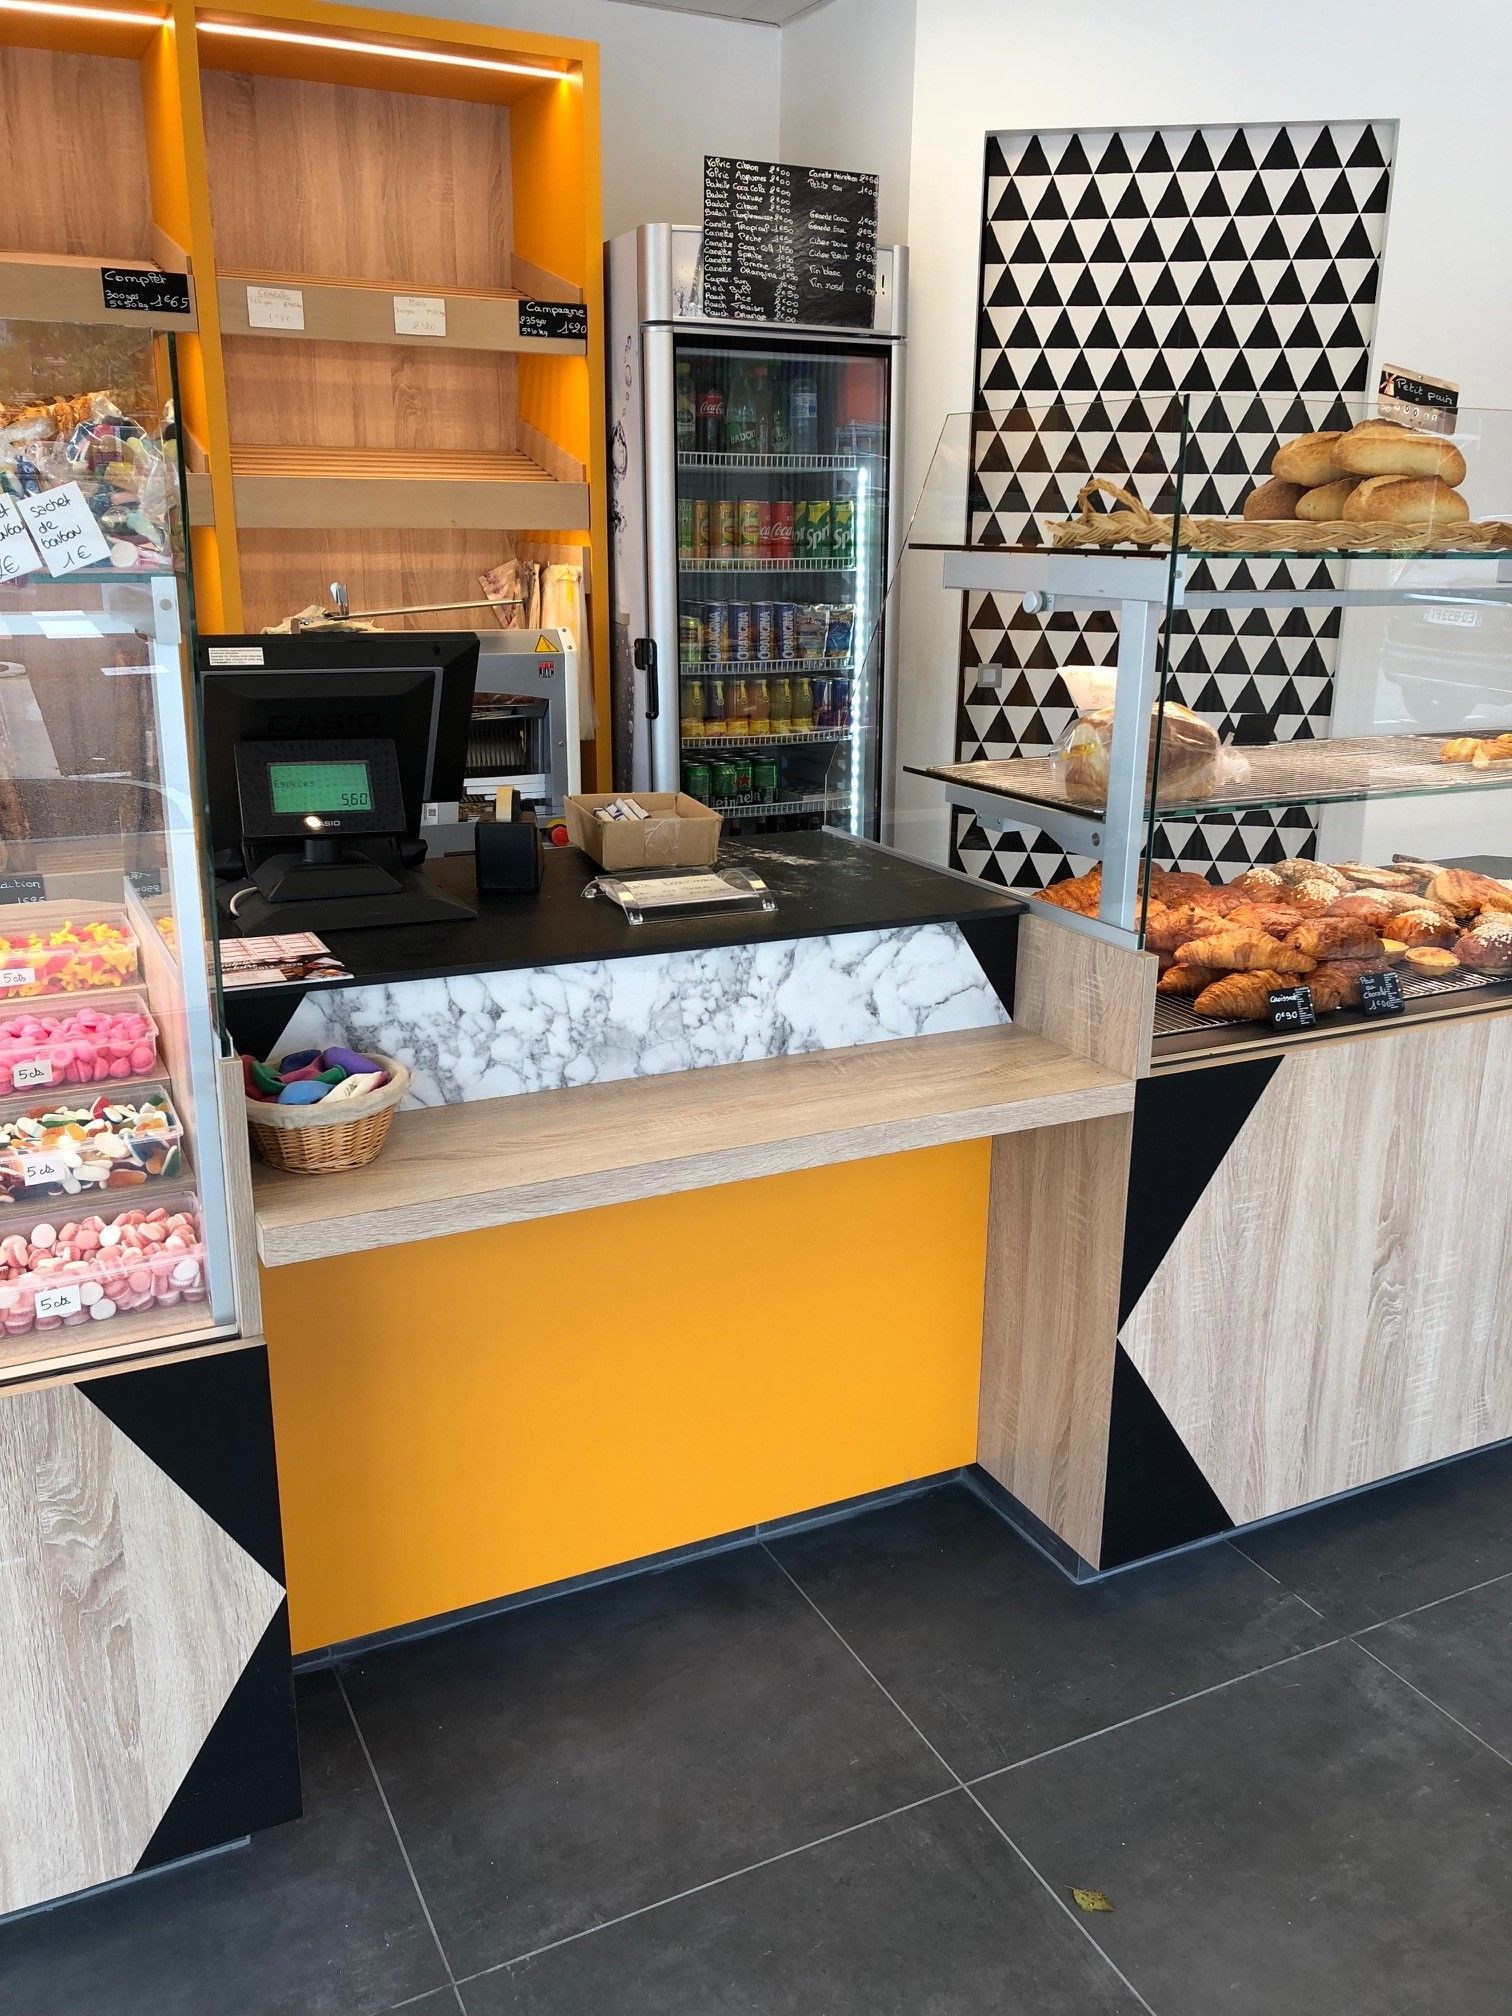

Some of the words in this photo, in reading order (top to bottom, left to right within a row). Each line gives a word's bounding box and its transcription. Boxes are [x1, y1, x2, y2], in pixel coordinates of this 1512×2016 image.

[104, 271, 166, 287] Complet
[150, 295, 190, 308] 1€65
[526, 302, 585, 318] Campagne
[557, 321, 587, 334] 1€20
[1396, 378, 1424, 395] Petit
[1427, 391, 1453, 405] pain
[39, 521, 58, 534] de
[806, 516, 830, 550] Spri
[41, 525, 81, 549] bonbon
[267, 711, 380, 733] CASIO
[4, 972, 11, 982] 5
[18, 1068, 27, 1080] 5
[27, 1165, 36, 1177] 5
[40, 1297, 51, 1310] 5
